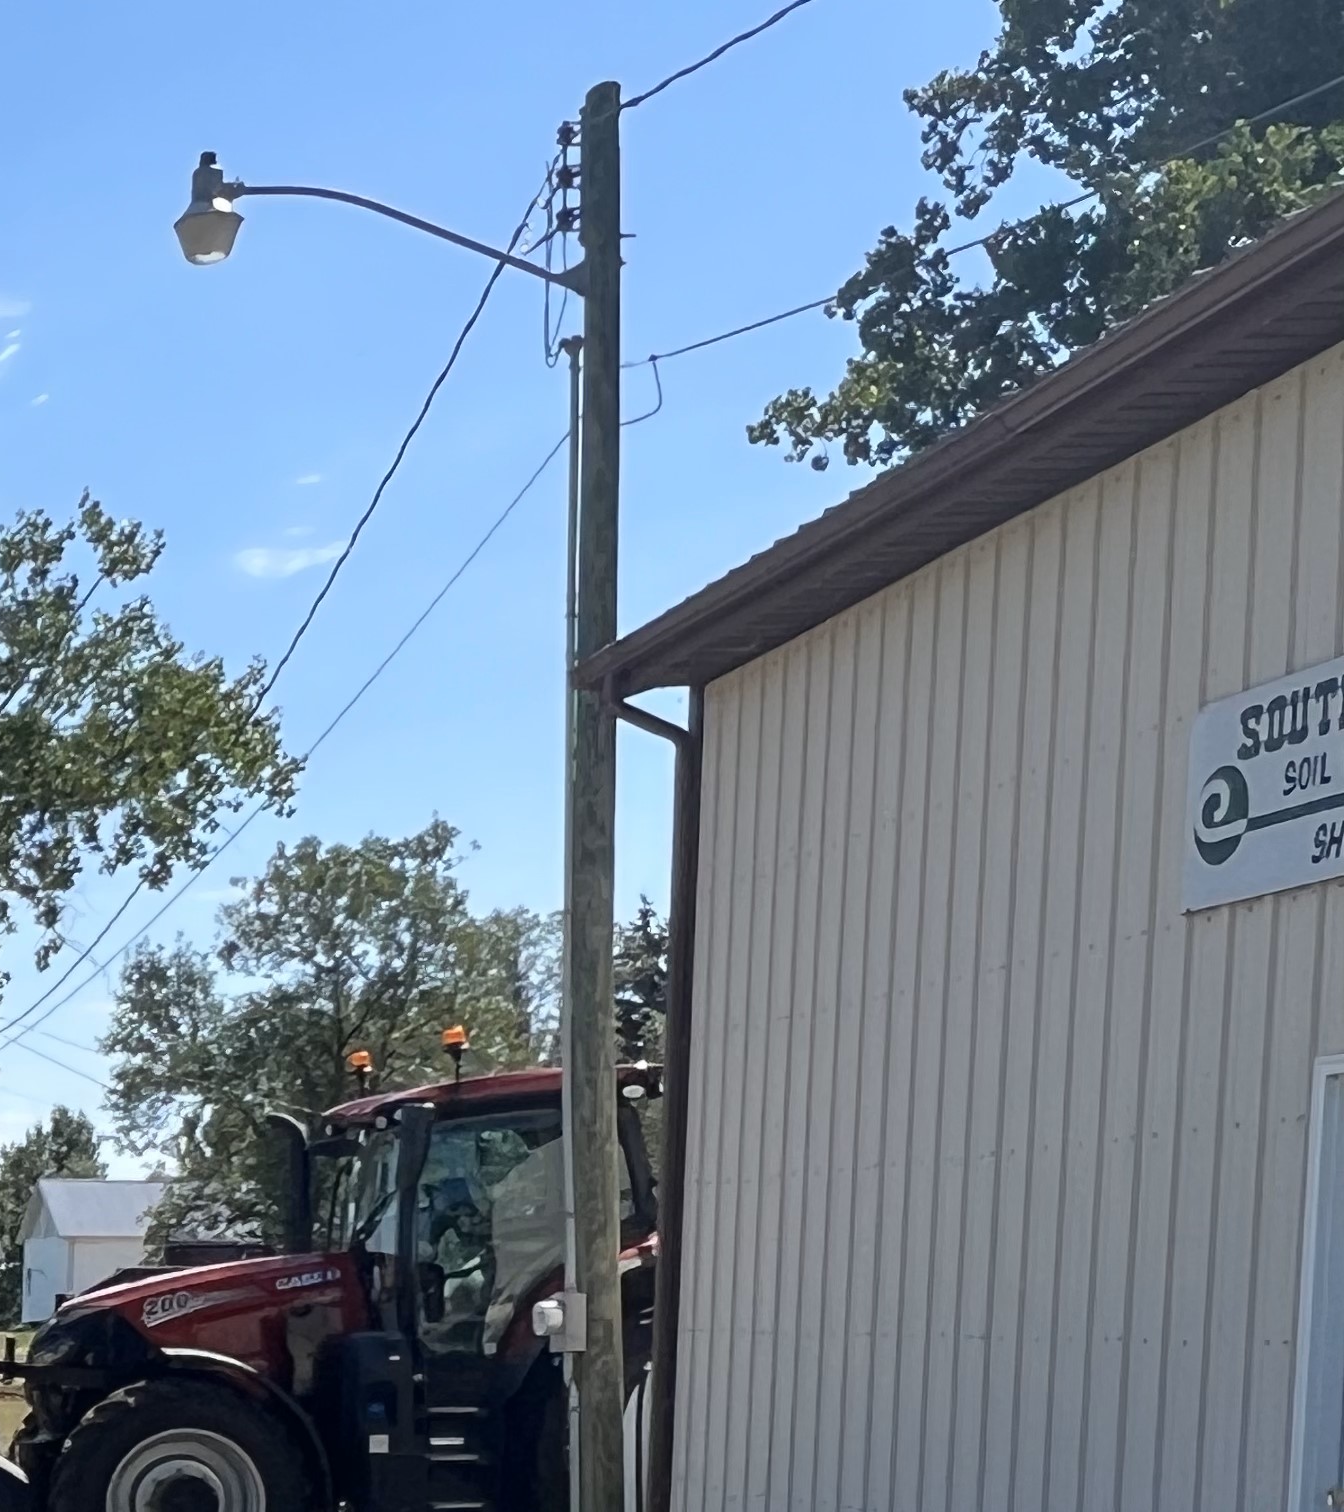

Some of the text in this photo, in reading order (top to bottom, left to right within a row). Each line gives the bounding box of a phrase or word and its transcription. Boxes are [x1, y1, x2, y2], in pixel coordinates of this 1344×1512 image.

[1237, 676, 1344, 760] SOUT
[1283, 753, 1331, 796] SOIL
[1311, 820, 1344, 864] SH
[143, 1291, 190, 1316] 200
